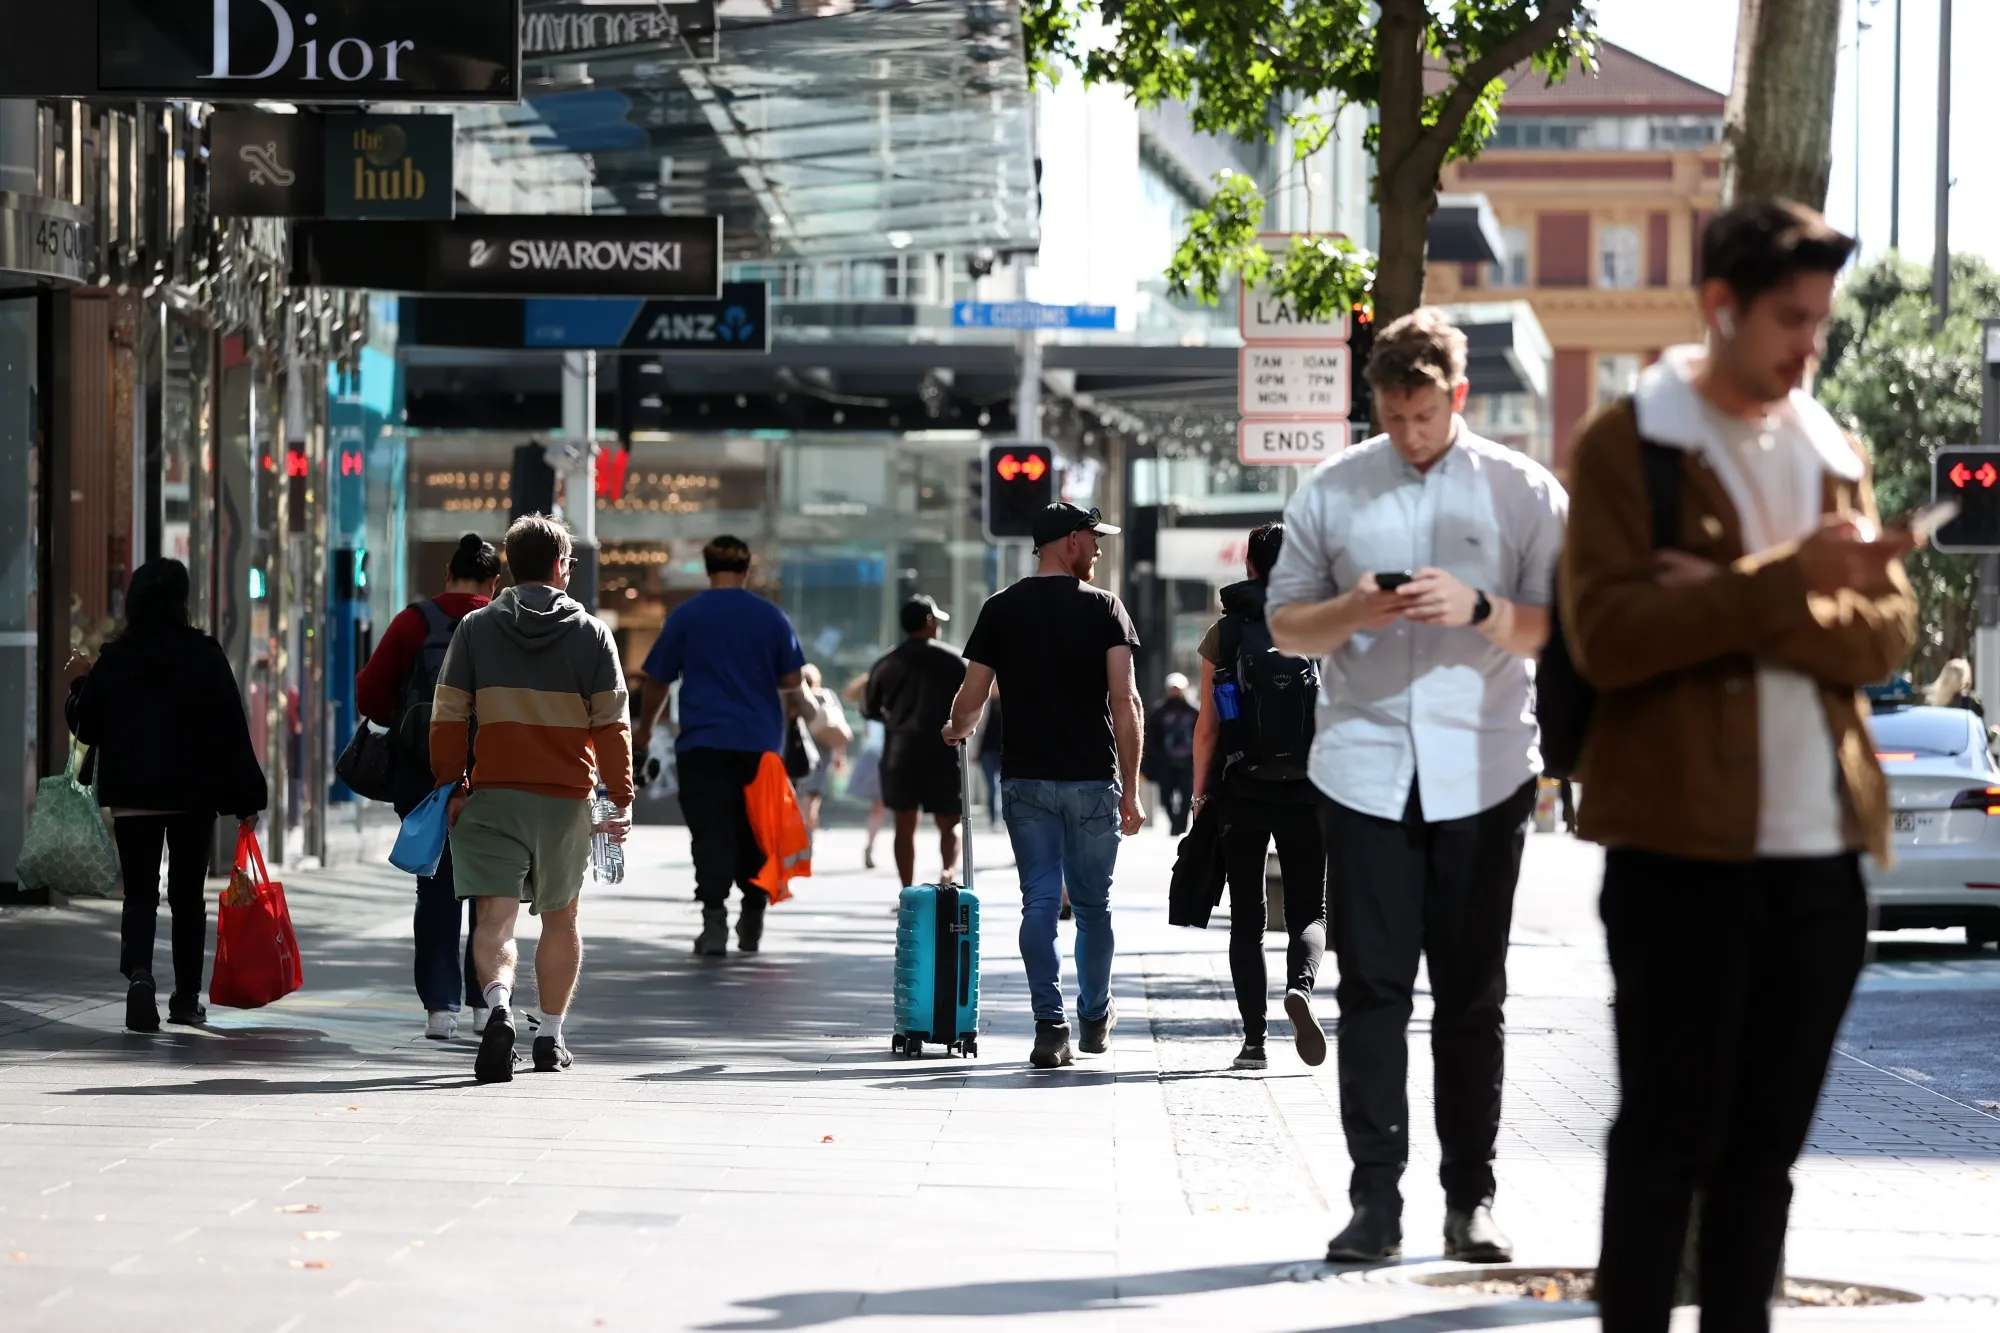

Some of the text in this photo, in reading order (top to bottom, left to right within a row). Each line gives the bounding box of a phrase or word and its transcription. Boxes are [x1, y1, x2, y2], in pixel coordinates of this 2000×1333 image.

[196, 0, 415, 82] Dior
[353, 127, 383, 150] the
[354, 156, 426, 200] hub
[36, 219, 58, 255] 45
[508, 238, 682, 271] SWAROVSKI
[1256, 300, 1330, 325] LA
[646, 313, 716, 340] ANZ
[1253, 355, 1282, 368] 7AM
[1303, 355, 1338, 369] 10AM
[1256, 374, 1285, 386] 4PM
[1308, 374, 1335, 386] 7PM
[1258, 391, 1288, 404] MON
[1309, 391, 1331, 404] FRI
[1263, 430, 1325, 452] ENDS
